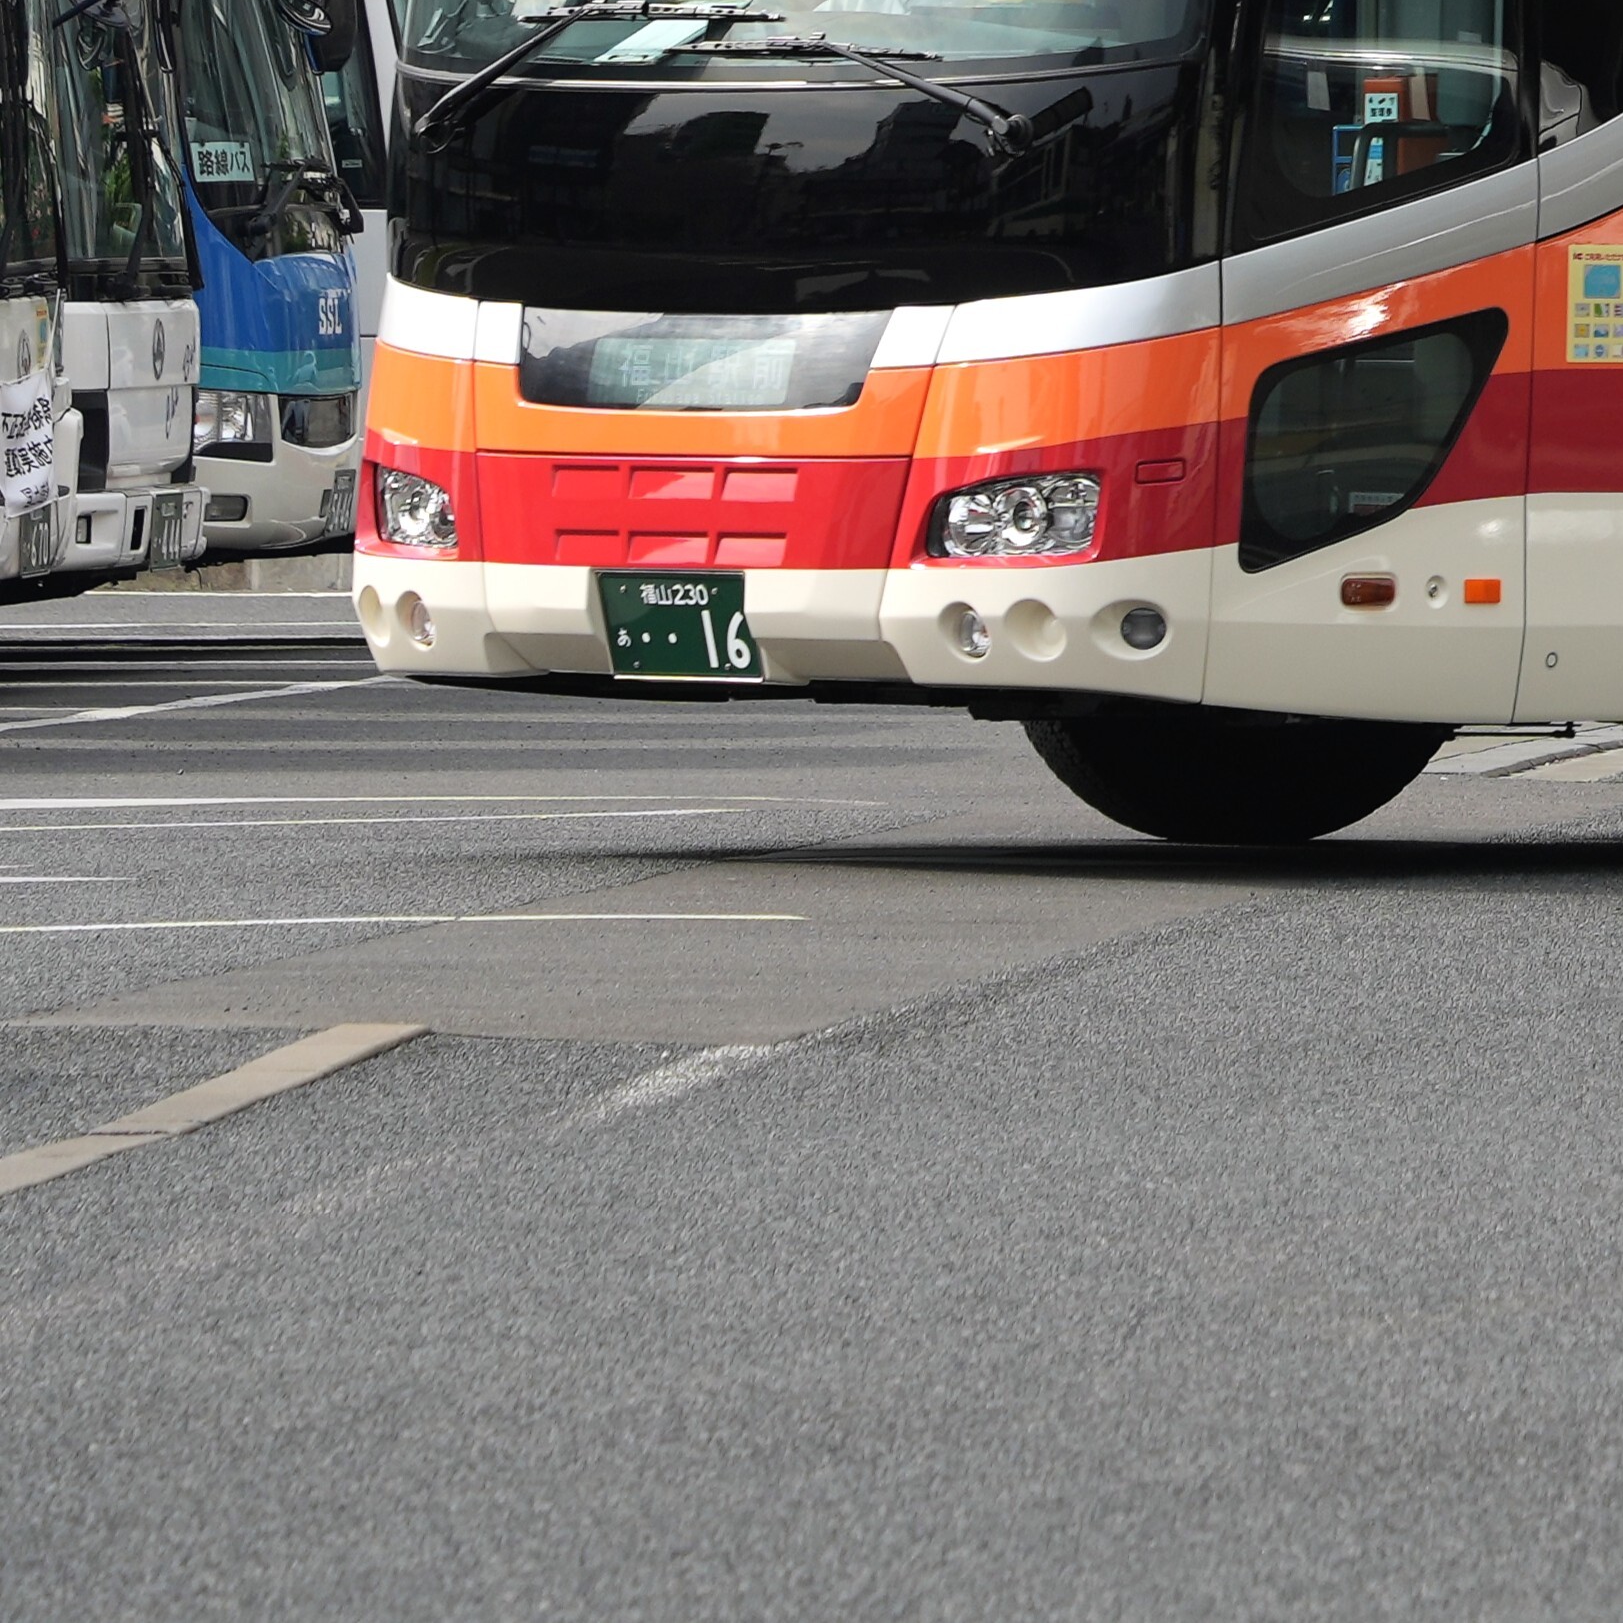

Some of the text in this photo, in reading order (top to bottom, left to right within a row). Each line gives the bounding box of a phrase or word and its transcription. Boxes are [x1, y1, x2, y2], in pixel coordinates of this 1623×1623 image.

[198, 149, 251, 177] 路線バス
[319, 298, 342, 335] SSL
